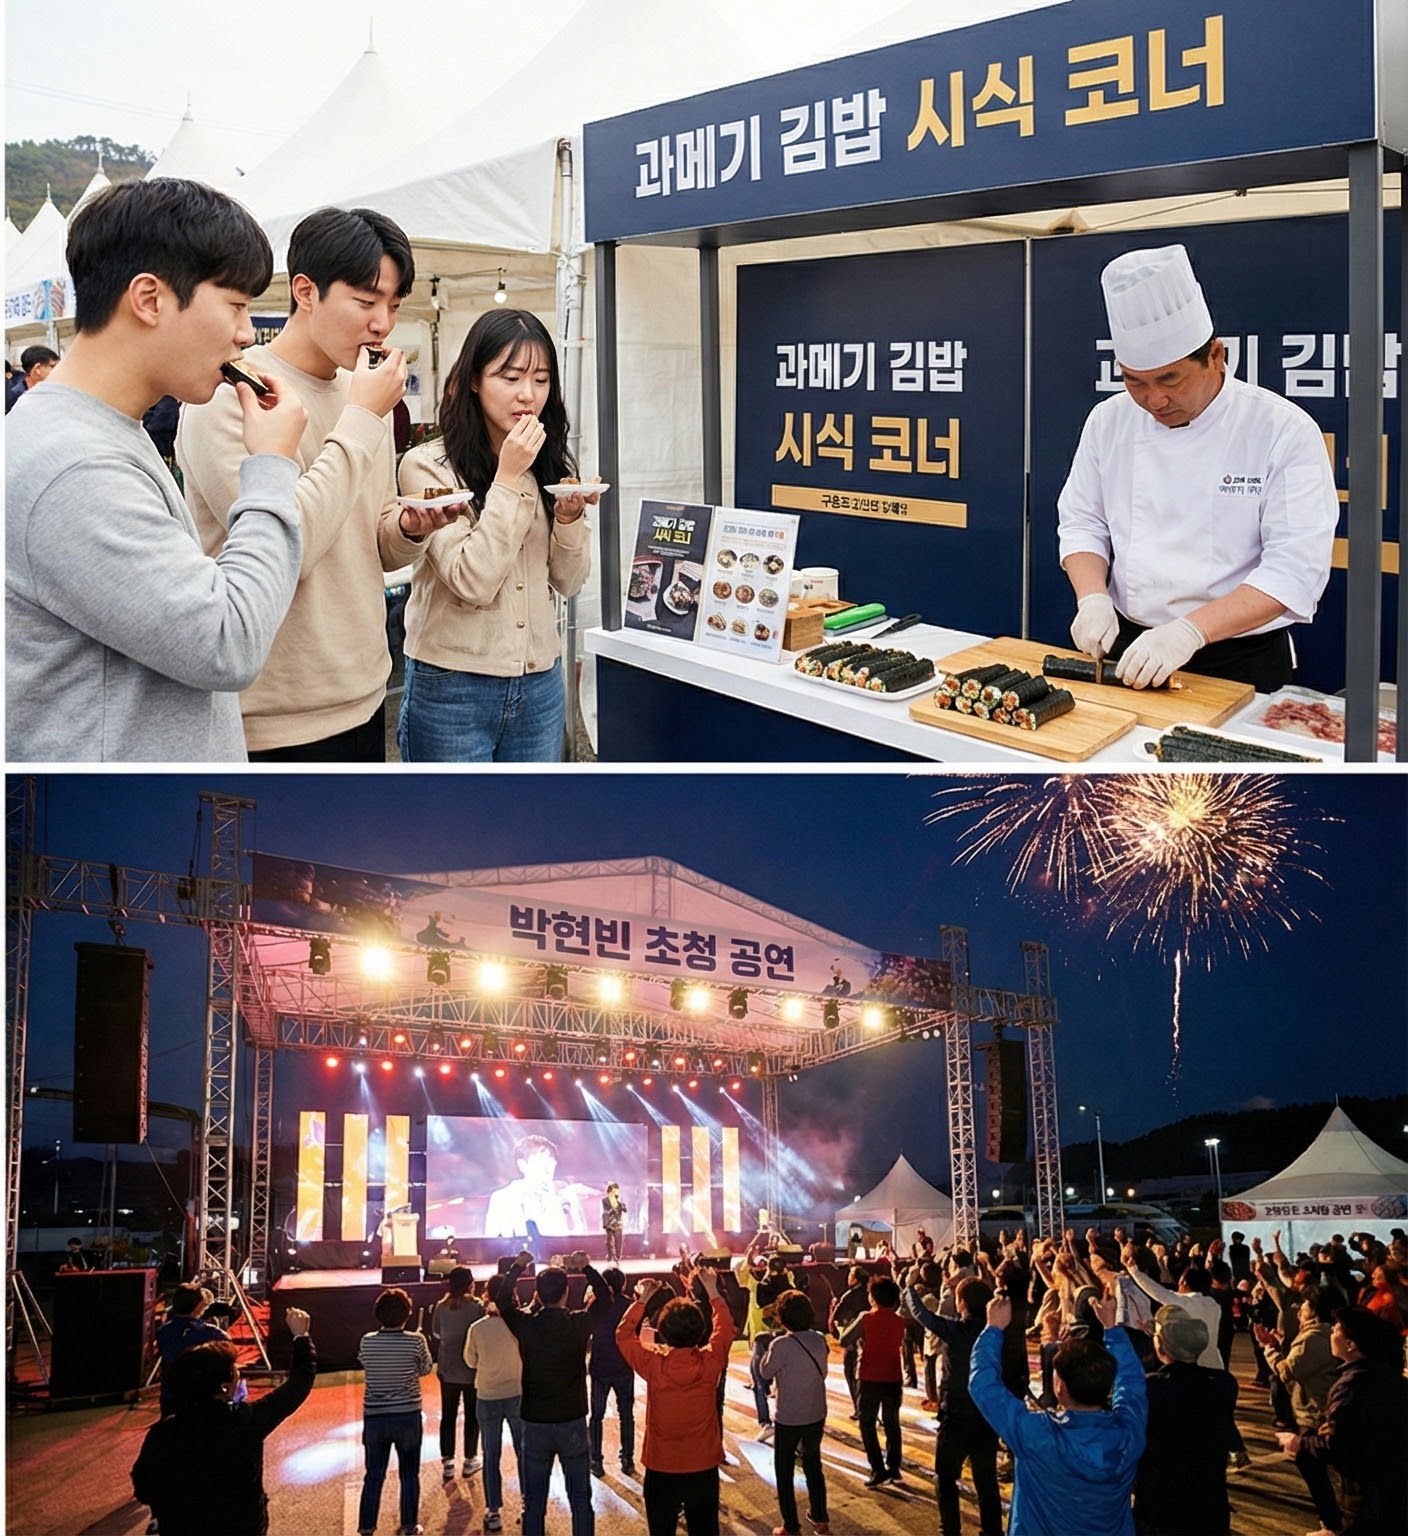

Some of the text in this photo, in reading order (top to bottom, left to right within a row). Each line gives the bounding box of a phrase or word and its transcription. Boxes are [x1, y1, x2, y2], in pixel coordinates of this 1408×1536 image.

[636, 14, 1224, 198] 과메기 김밥 시식 코너
[776, 341, 967, 392] 과메기 김밥
[776, 412, 960, 479] 시식 코너
[510, 904, 795, 982] 박현빈 초청 공연
